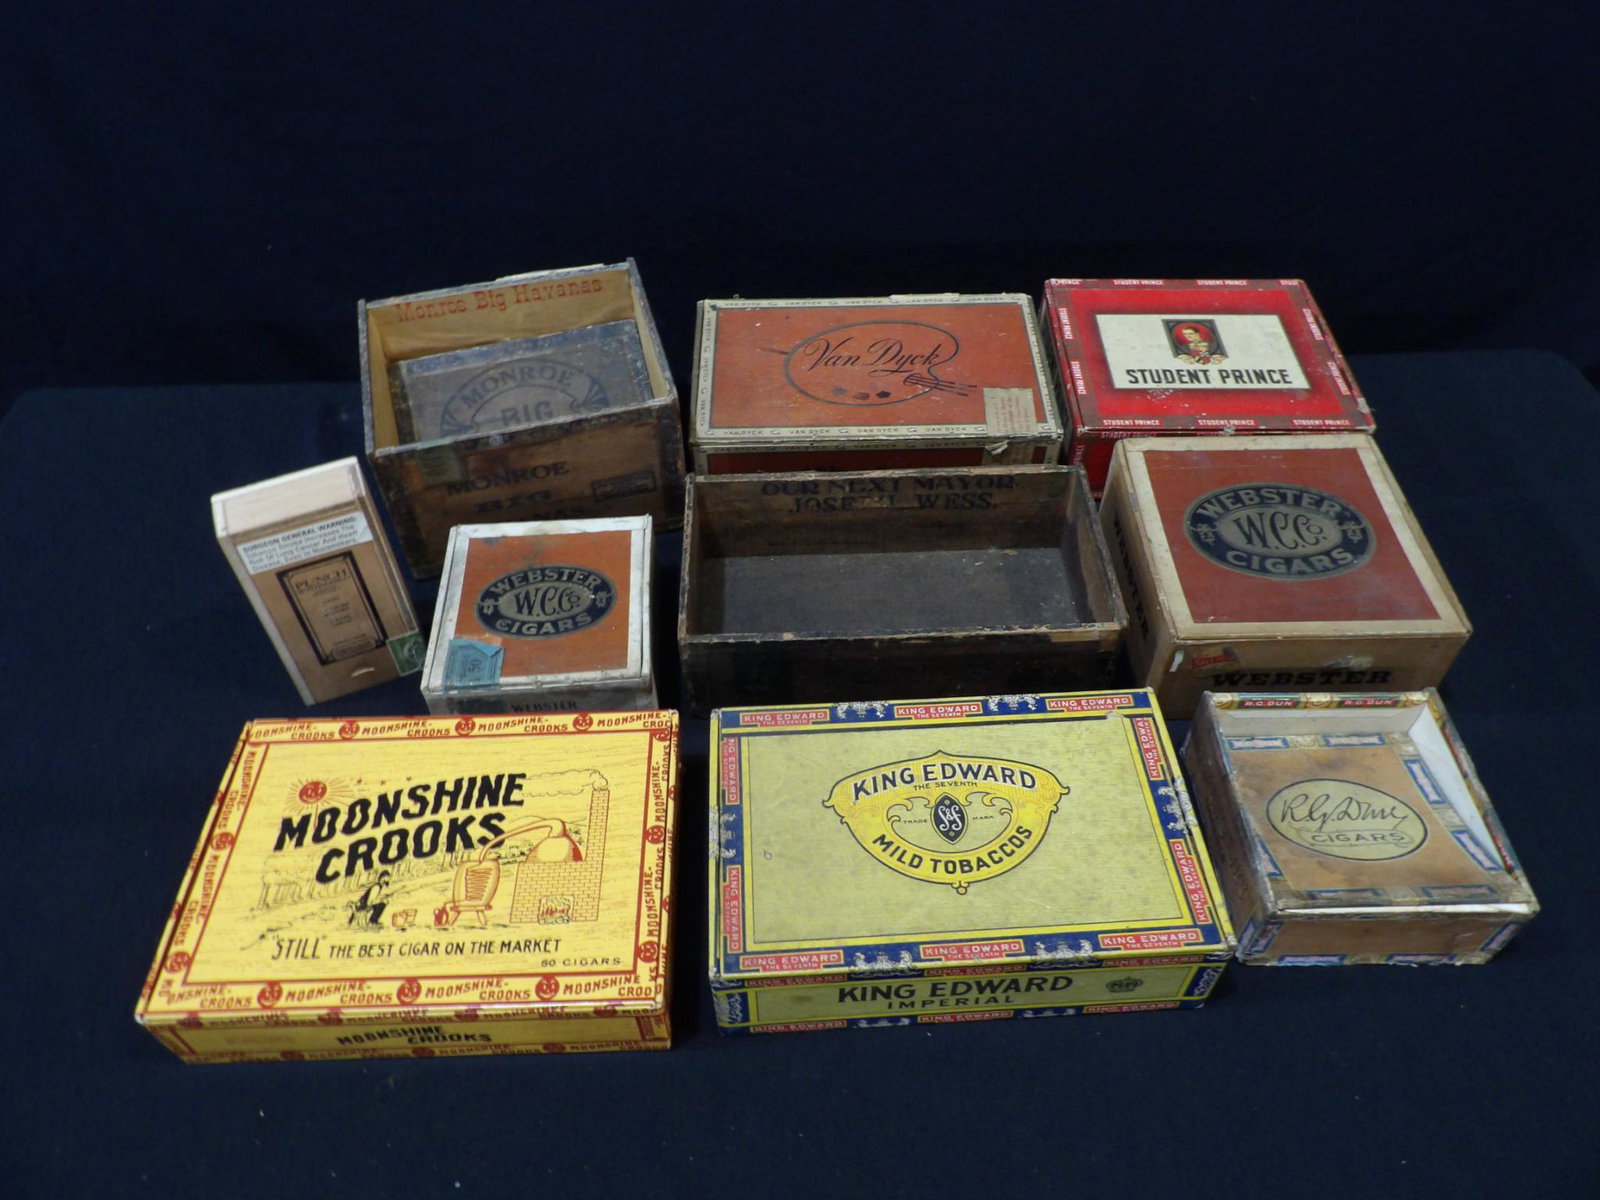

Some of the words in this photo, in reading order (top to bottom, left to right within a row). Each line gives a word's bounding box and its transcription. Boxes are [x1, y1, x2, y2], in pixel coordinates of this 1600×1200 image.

[393, 298, 468, 322] Monroe
[473, 290, 508, 312] Big
[513, 278, 603, 304] Havanas
[804, 336, 862, 371] Van
[866, 338, 942, 378] Dyck
[460, 363, 577, 410] MONROE
[1125, 368, 1212, 385] STUDENT
[1218, 368, 1293, 385] PRINCE
[500, 401, 555, 426] BIG
[447, 461, 572, 496] MONROE
[762, 481, 819, 496] OUR
[829, 478, 899, 494] NEXT
[474, 489, 553, 513] BIG
[1197, 488, 1336, 518] WEBSTER
[242, 538, 280, 554] SURGEON
[281, 528, 316, 543] GENERAL
[1226, 547, 1354, 575] CIGARS
[488, 568, 603, 597] WEBSTER
[495, 612, 593, 636] CIGARS
[1211, 670, 1393, 688] WEBSTER
[511, 700, 578, 713] WEBSTER
[897, 707, 926, 716] KING
[929, 704, 979, 714] EDWARD
[1049, 699, 1078, 709] KING
[1081, 696, 1129, 706] EDWARD
[743, 713, 774, 723] KING
[777, 711, 826, 721] EDWARD
[290, 731, 335, 741] CROOKS
[406, 728, 451, 738] CROOKS
[523, 724, 569, 733] CROOKS
[727, 760, 738, 802] EDWARD
[853, 766, 916, 802] KING
[923, 762, 1037, 790] EDWARD
[913, 783, 932, 792] THE
[935, 780, 978, 788] SEVENTH
[273, 772, 528, 854] MOONSHINE
[315, 811, 507, 885] CROOKS
[1311, 832, 1406, 844] CIGARS
[872, 832, 924, 870] MILD
[929, 825, 1034, 875] TOBACCOS
[1173, 842, 1198, 890] EDWARD
[729, 867, 739, 893] KING
[1193, 893, 1208, 921] KING
[730, 894, 740, 951] EDWARD
[328, 944, 354, 959] THE
[358, 943, 393, 958] BEST
[398, 942, 442, 956] CIGAR
[444, 941, 463, 956] ON
[470, 940, 495, 955] THE
[499, 938, 562, 954] MARKET
[1102, 936, 1136, 946] KING
[1139, 931, 1198, 943] EDWARD
[744, 957, 776, 967] KING
[781, 952, 839, 964] EDWARD
[925, 946, 959, 957] KING
[962, 943, 1018, 954] EDWARD
[541, 958, 557, 968] 50
[562, 956, 622, 967] CIGARS
[478, 989, 532, 1001] CROOKS
[563, 974, 641, 995] MOONSHINE
[838, 983, 916, 1003] KING
[929, 975, 1073, 998] EDWARD
[200, 997, 253, 1010] CROOKS
[339, 992, 393, 1005] CROOKS
[887, 995, 1015, 1010] IMPERIAL
[336, 1025, 444, 1046] MOONSHINE
[407, 1032, 492, 1045] CROOKS
